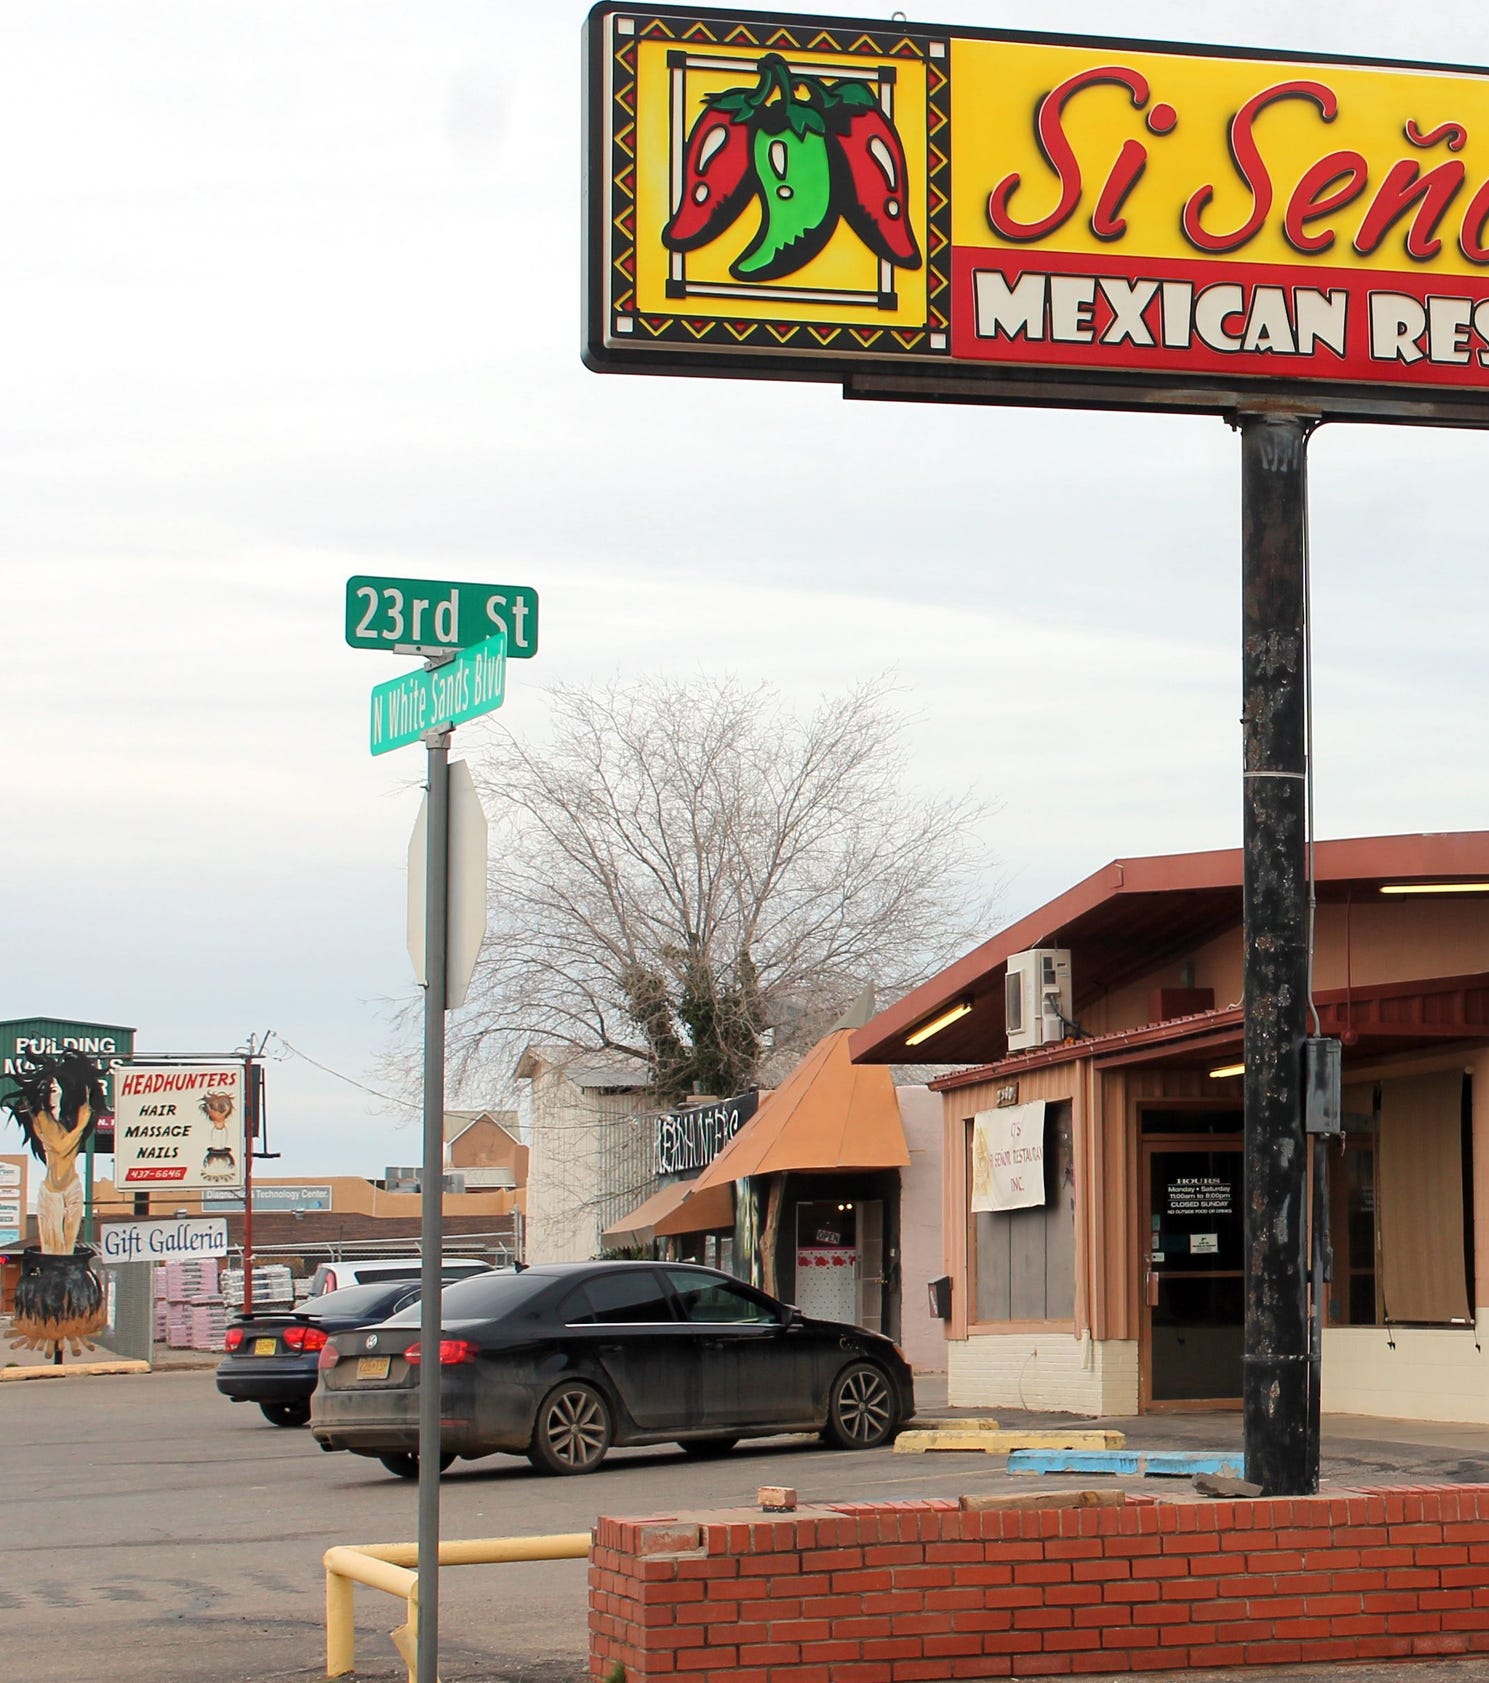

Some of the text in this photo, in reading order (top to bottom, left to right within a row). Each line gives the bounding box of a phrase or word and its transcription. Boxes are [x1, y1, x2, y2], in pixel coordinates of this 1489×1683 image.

[989, 66, 1177, 243] Si
[972, 267, 1349, 359] MEXICAN
[355, 586, 529, 648] 23rd St
[373, 639, 504, 745] N White Sands Blvd
[121, 1072, 237, 1097] HEADHUNTERS
[139, 1104, 177, 1117] HAIR
[125, 1125, 193, 1138] MASSAGE
[136, 1146, 179, 1159] NAILS
[130, 1168, 183, 1179] 437-6646
[255, 1189, 300, 1201] Technology
[104, 1223, 226, 1263] Gift Galleria
[817, 1230, 840, 1244] OPEN
